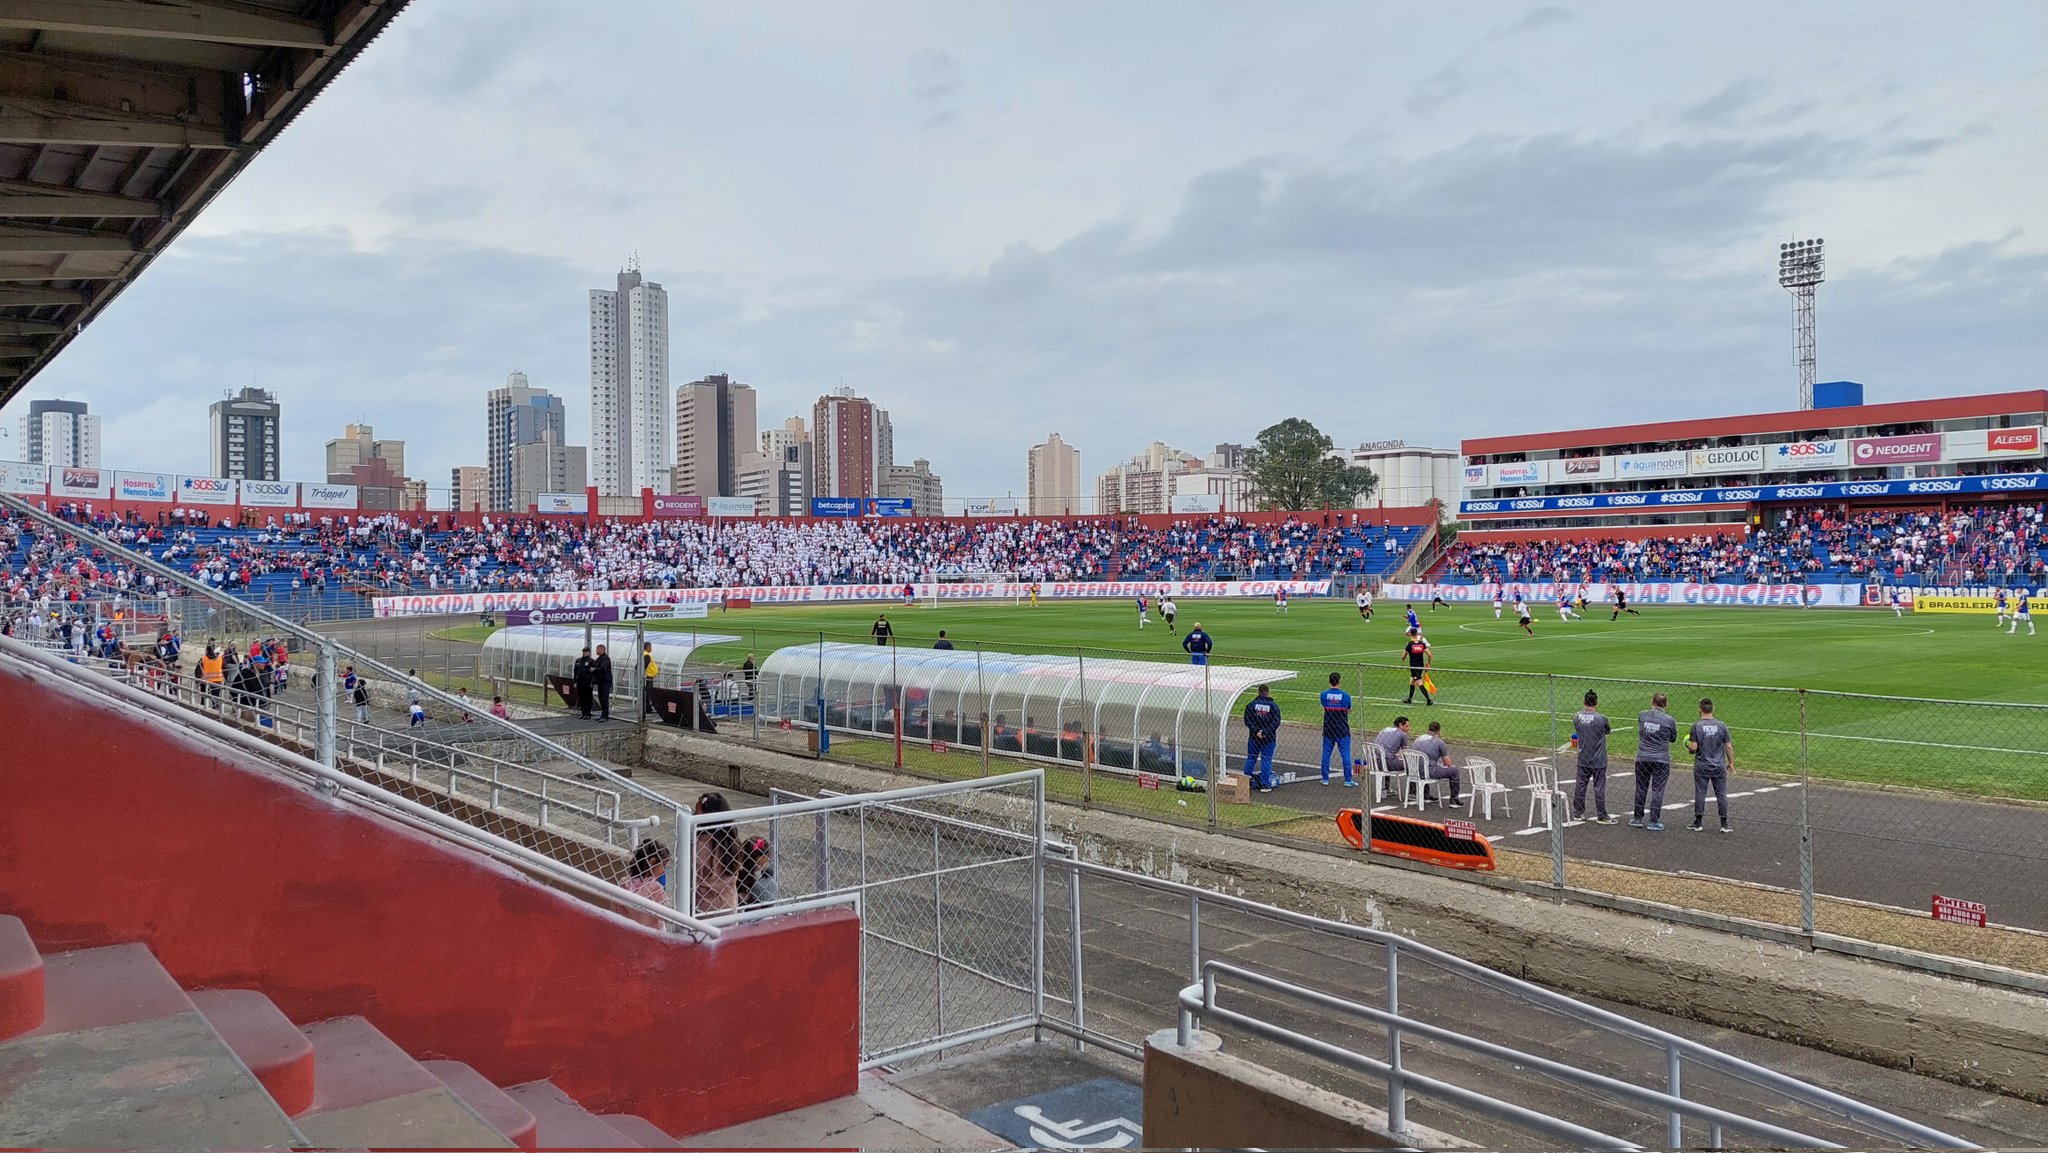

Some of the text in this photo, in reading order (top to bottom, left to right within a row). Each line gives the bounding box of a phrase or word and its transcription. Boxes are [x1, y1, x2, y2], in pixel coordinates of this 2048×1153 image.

[1993, 435, 2032, 445] ALESSI
[1790, 442, 1836, 455] SOSSul
[1875, 443, 1933, 455] NEODENT
[1708, 451, 1759, 463] GEOLOC
[192, 479, 229, 491] SOSSul
[1918, 481, 1963, 492] SOSSul
[1990, 477, 2038, 489] SOSSul
[149, 489, 165, 497] Deus
[254, 484, 289, 495] SOSSul
[311, 488, 348, 500] Tróppel
[1785, 487, 1825, 497] SOSSul
[1849, 484, 1891, 495] SOSSul
[1614, 495, 1647, 504] SOSSul
[1669, 492, 1703, 502] SOSSul
[1724, 490, 1761, 500] SOSSul
[818, 501, 855, 509] betcapital
[1472, 501, 1500, 510] SOSSul
[1516, 500, 1545, 508] SOSSul
[1564, 497, 1595, 506] SOSSul
[1408, 583, 1470, 600] DIGO
[402, 595, 475, 614] TORCIDA
[482, 592, 601, 612] ORGANIZADA
[823, 585, 912, 599] TRICOLO
[937, 584, 994, 597] DESDE
[1052, 583, 1172, 597] DEFENDENDO
[1181, 583, 1227, 595] SUAS
[546, 611, 596, 621] NEODENT
[624, 606, 648, 619] HS
[1971, 912, 1981, 920] NO
